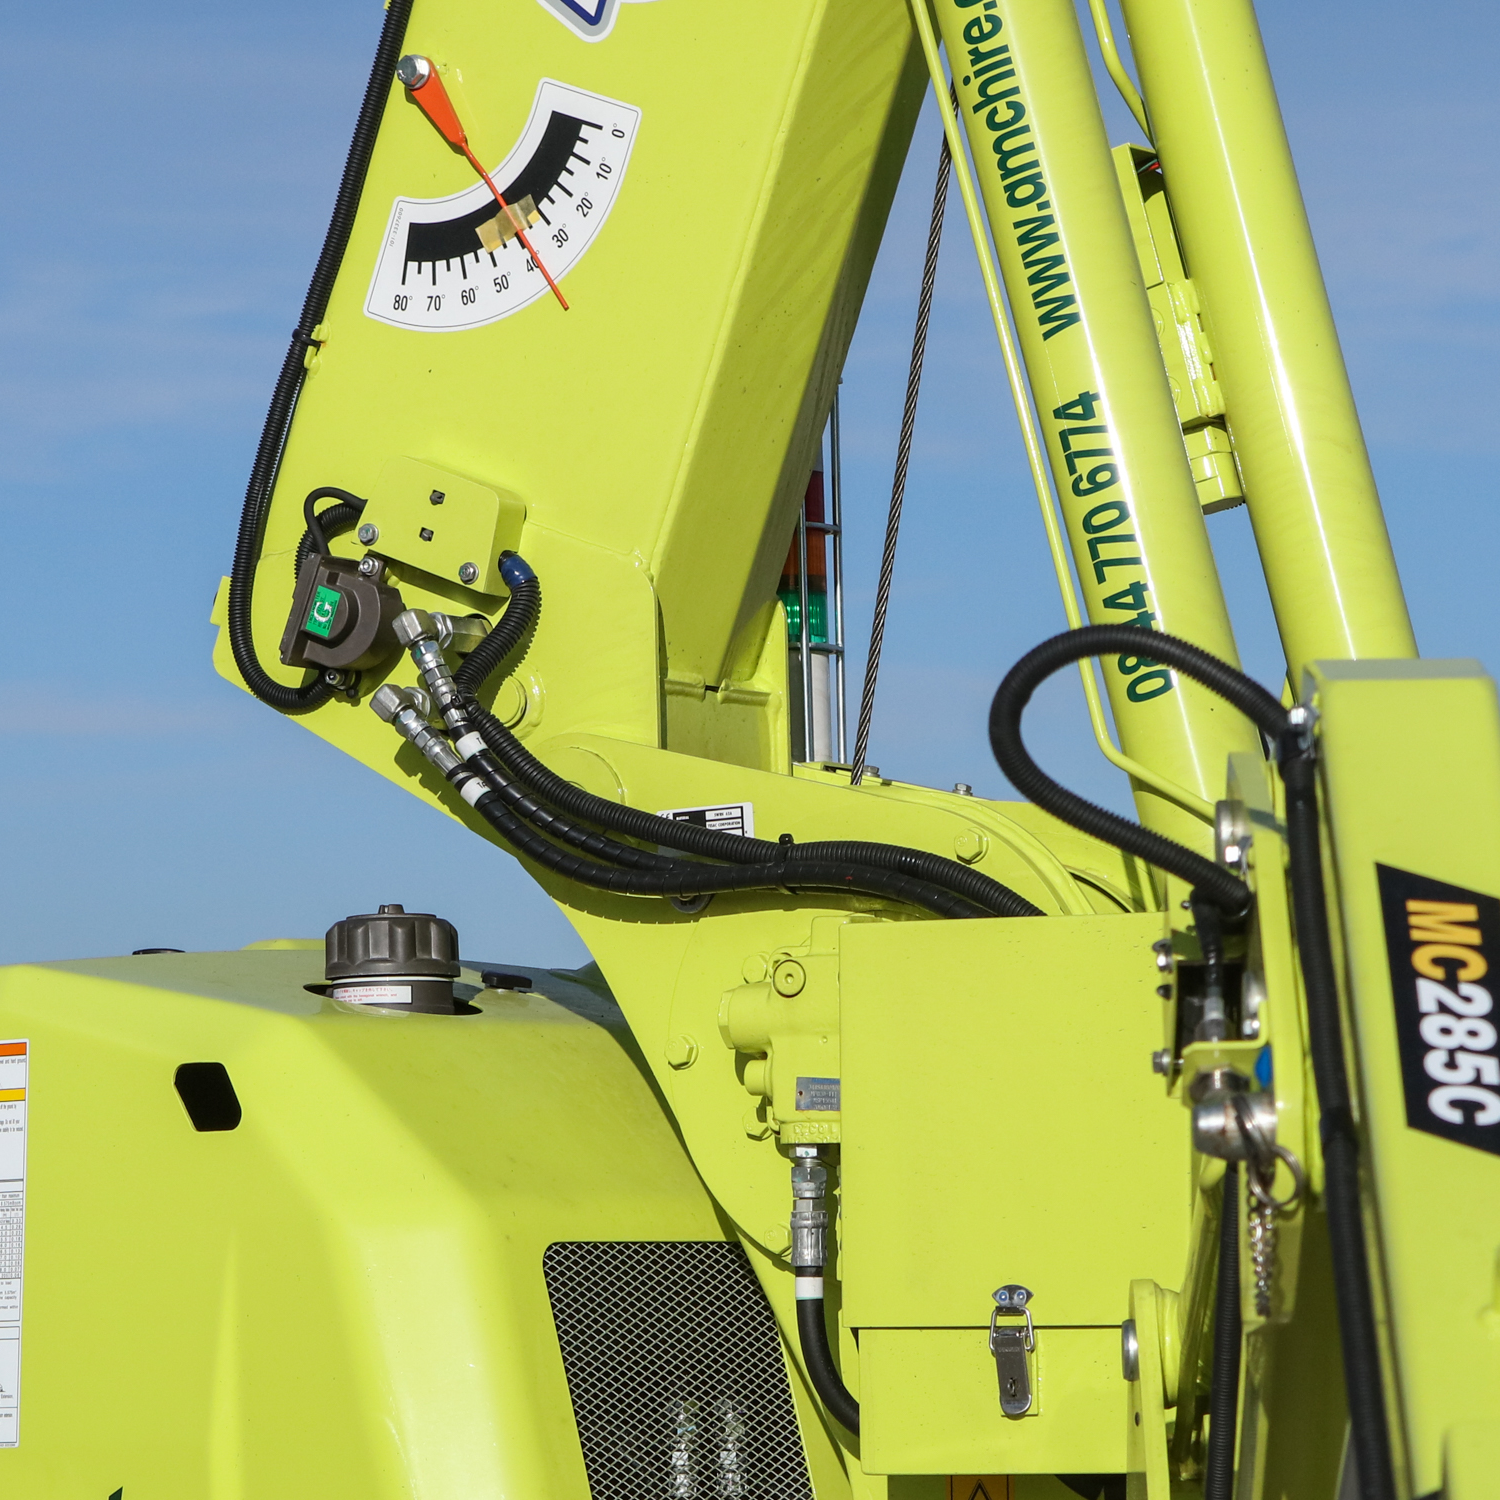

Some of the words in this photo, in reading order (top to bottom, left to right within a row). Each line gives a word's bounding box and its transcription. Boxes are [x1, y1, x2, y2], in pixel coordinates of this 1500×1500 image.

[953, 0, 1082, 342] www.amchire.
[1053, 390, 1122, 497] 6774
[1082, 501, 1145, 585] 770
